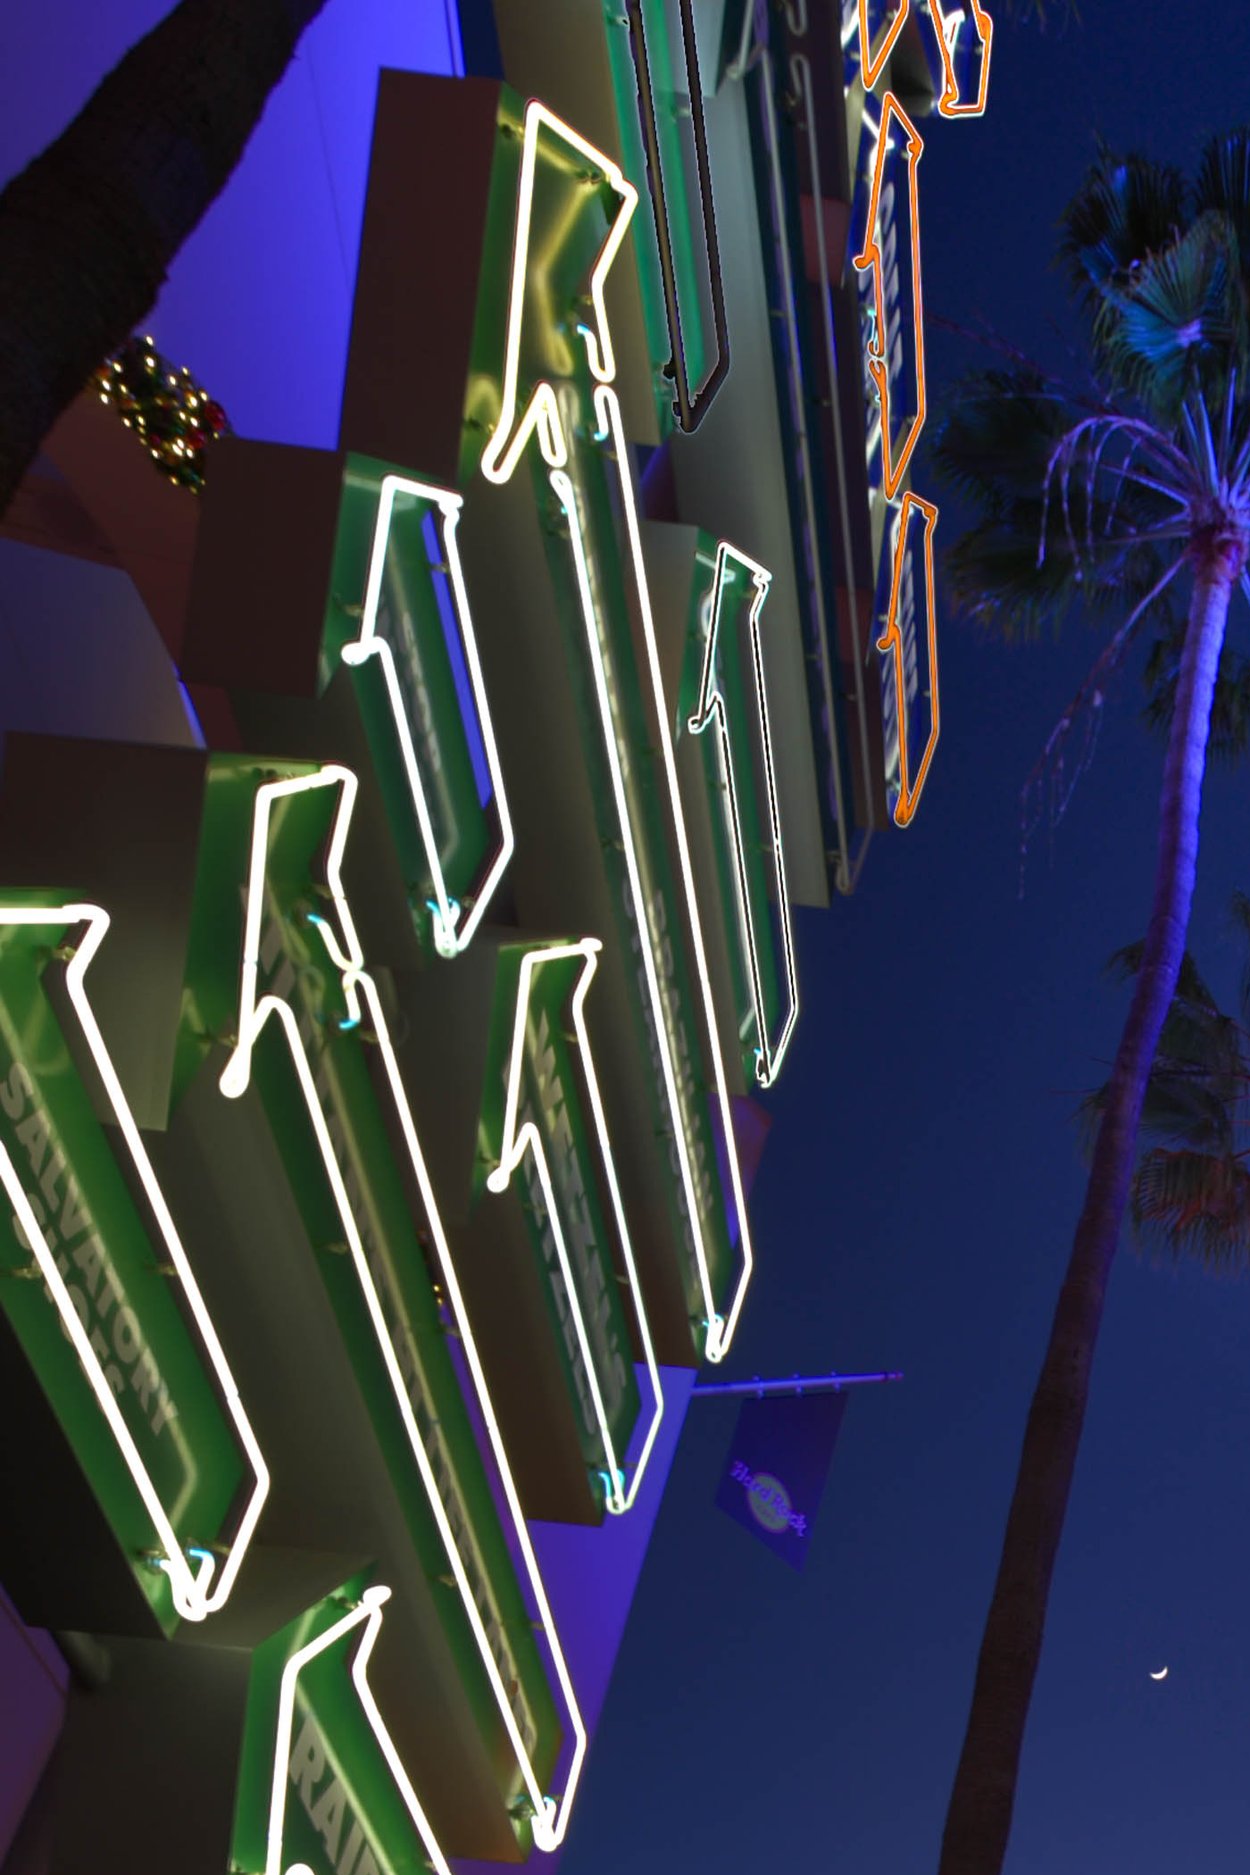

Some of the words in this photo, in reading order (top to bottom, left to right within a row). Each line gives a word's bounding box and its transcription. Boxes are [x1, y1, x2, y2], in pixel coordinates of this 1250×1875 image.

[0, 1061, 180, 1437] SALVATORY
[534, 1006, 627, 1412] WETZEL'S
[728, 1459, 773, 1501] Hard
[771, 1493, 808, 1538] Rock
